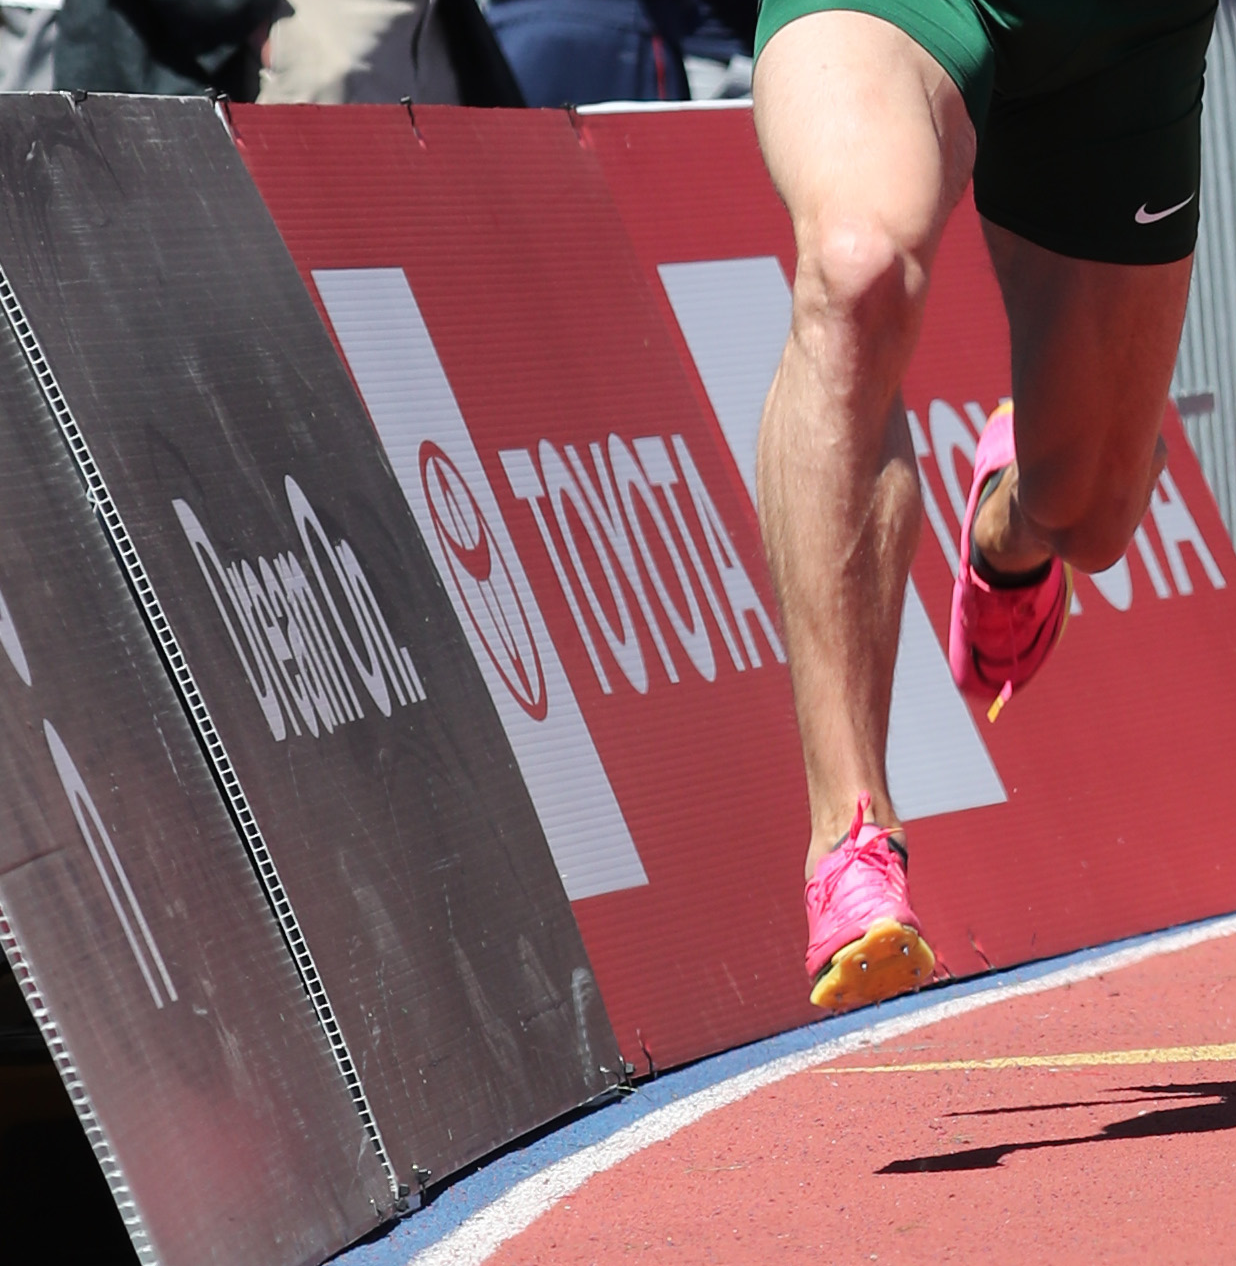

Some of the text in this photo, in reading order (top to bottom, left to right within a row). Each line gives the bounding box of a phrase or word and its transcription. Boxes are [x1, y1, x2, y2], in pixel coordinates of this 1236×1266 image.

[172, 474, 427, 741] Dream On.
[498, 432, 787, 695] TOYOTA
